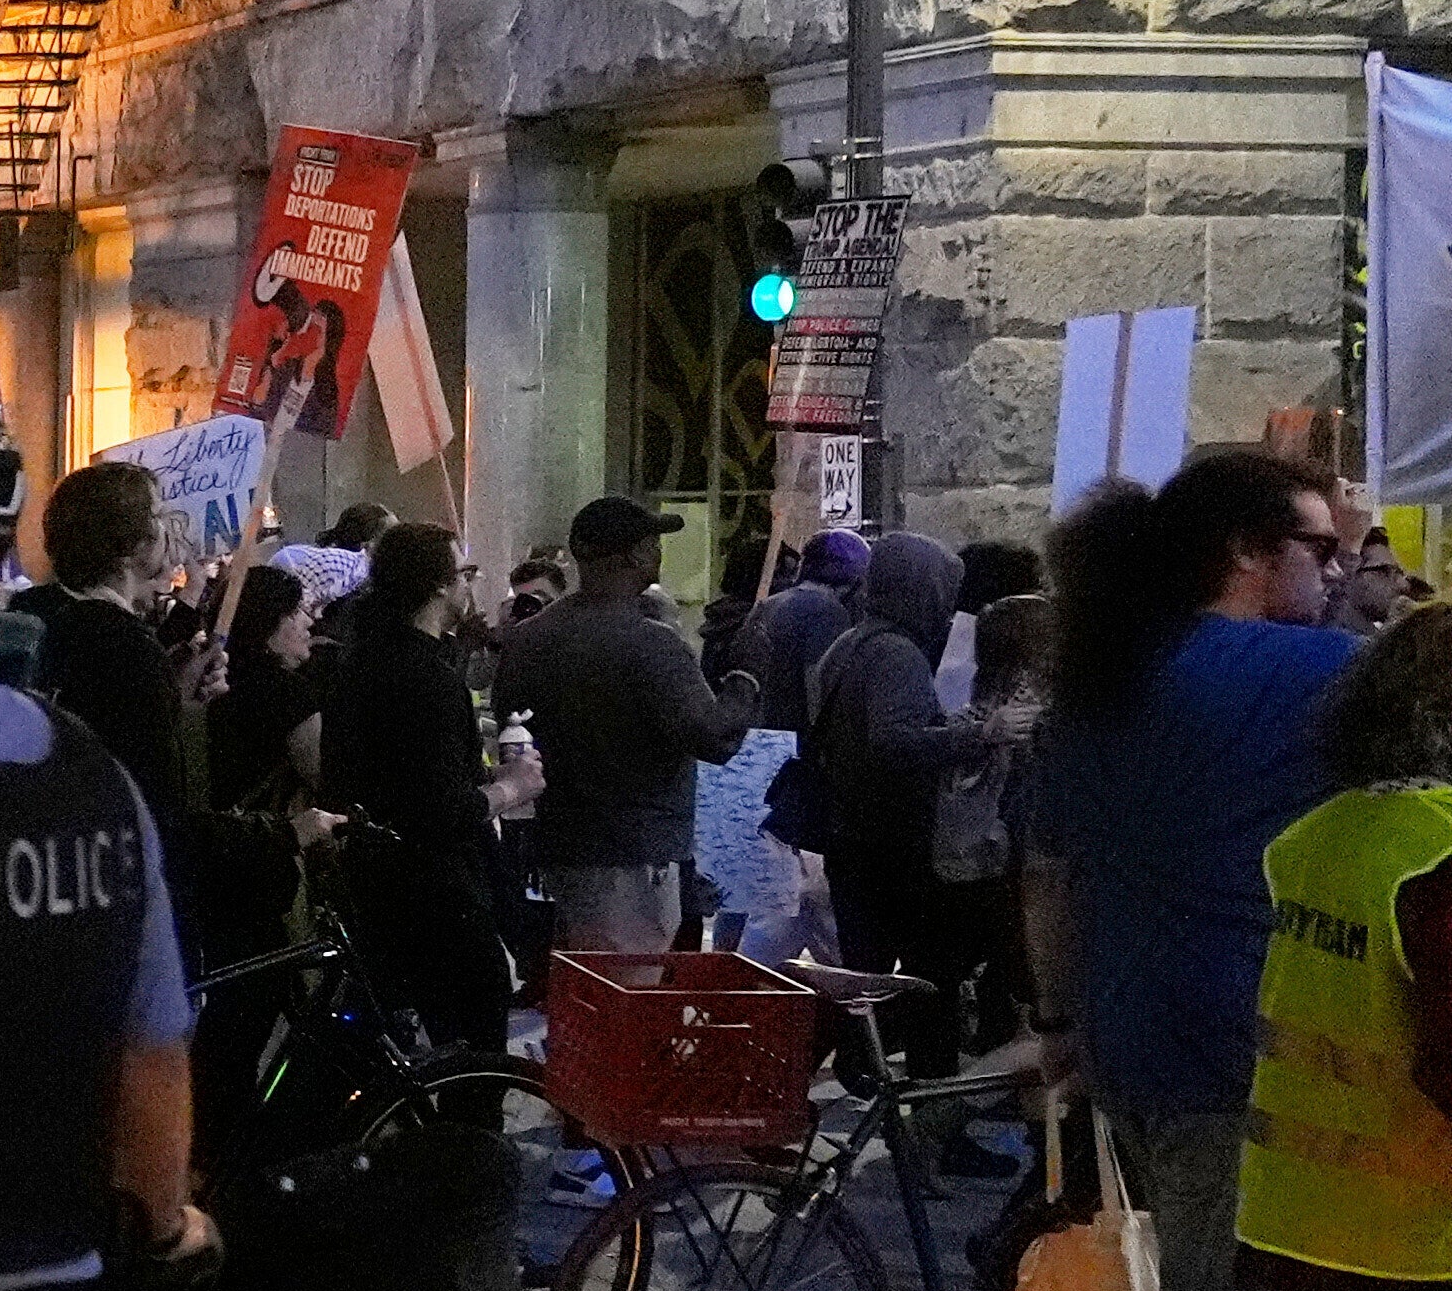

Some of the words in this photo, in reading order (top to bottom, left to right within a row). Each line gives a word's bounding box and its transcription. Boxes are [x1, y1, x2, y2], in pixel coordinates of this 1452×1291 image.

[290, 164, 335, 196] STOP
[283, 193, 377, 231] DEPORTATIONS
[810, 204, 860, 239] STOP
[864, 201, 903, 239] THE
[305, 225, 369, 264] DEFEND
[270, 248, 363, 292] IMMIGRANTS
[156, 423, 257, 490] Liberty
[826, 442, 856, 464] ONE
[161, 469, 228, 501] ustice
[825, 468, 855, 498] WAY
[204, 488, 255, 556] AL
